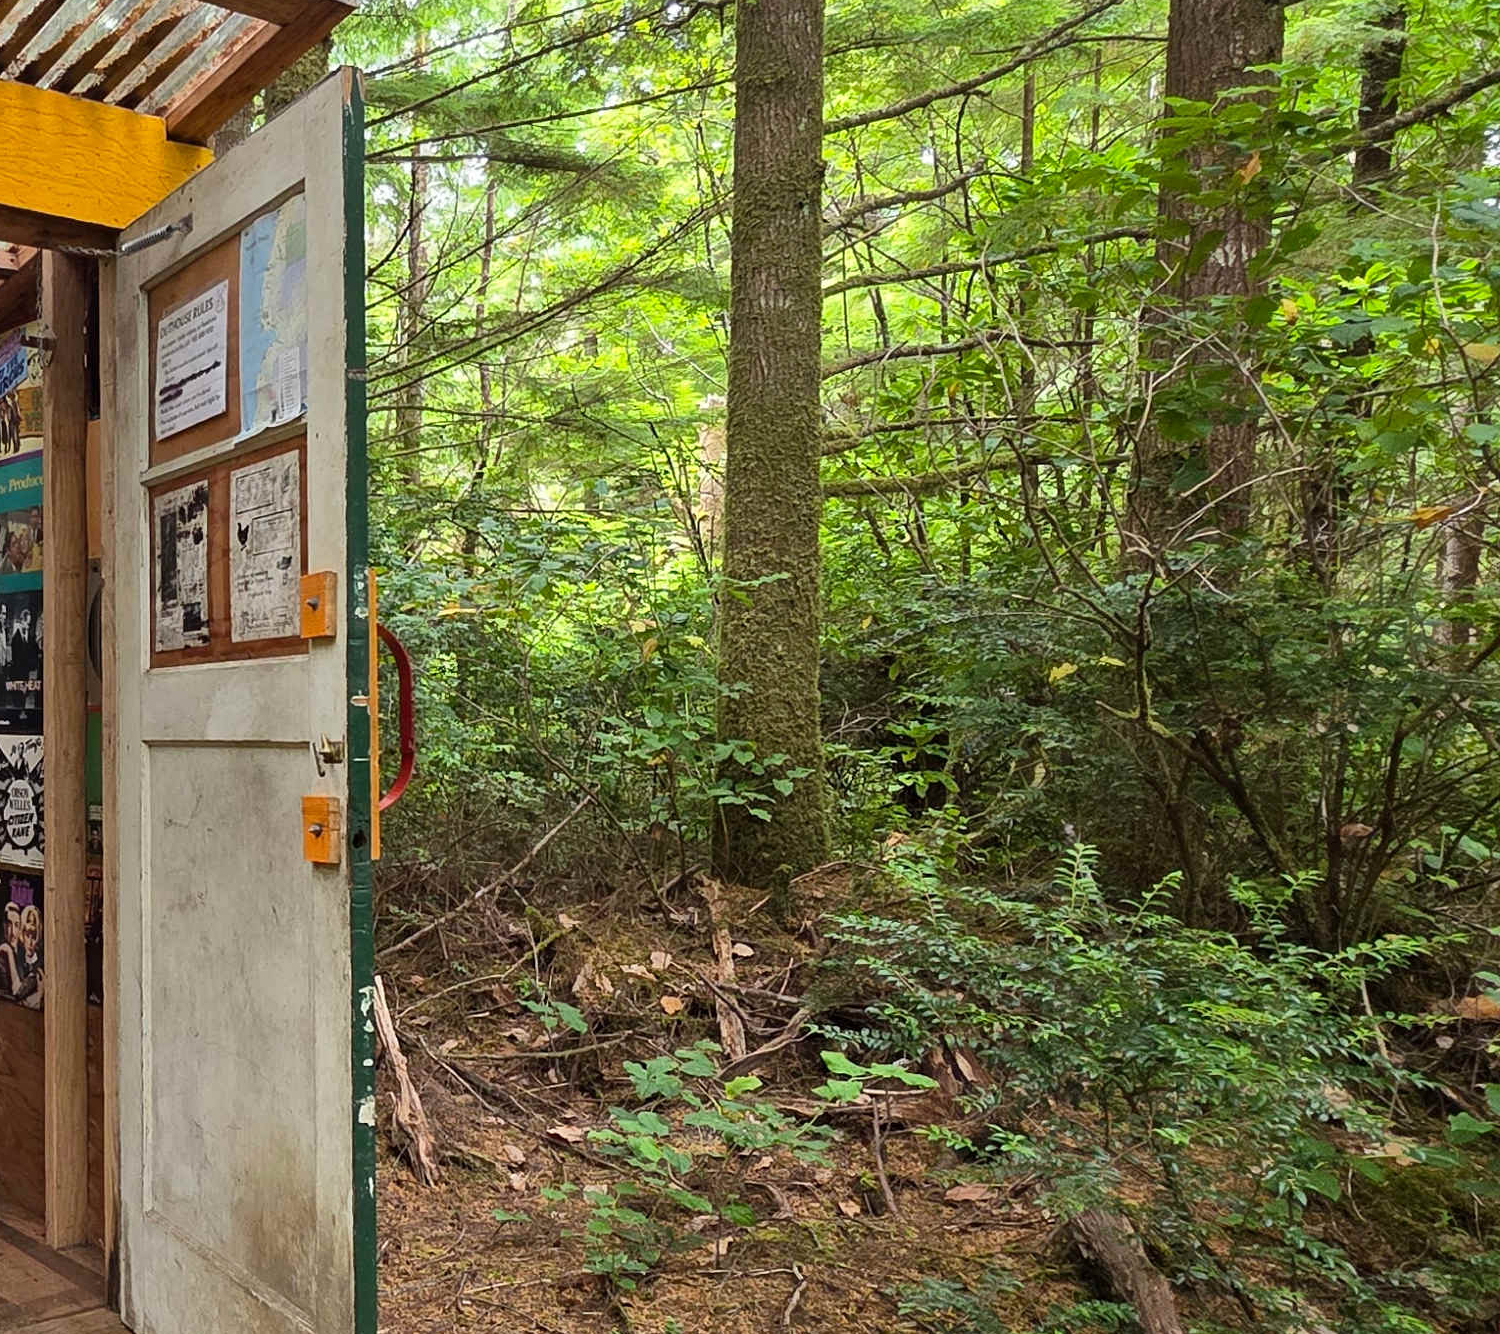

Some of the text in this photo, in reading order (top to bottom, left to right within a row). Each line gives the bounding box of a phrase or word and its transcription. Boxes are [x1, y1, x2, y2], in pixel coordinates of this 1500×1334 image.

[192, 297, 214, 319] RULES
[5, 680, 42, 692] WHITE HEAT
[11, 787, 29, 798] ORSON
[10, 798, 31, 811] WELLES
[8, 812, 35, 826] CITIZEN
[11, 825, 30, 838] KANE
